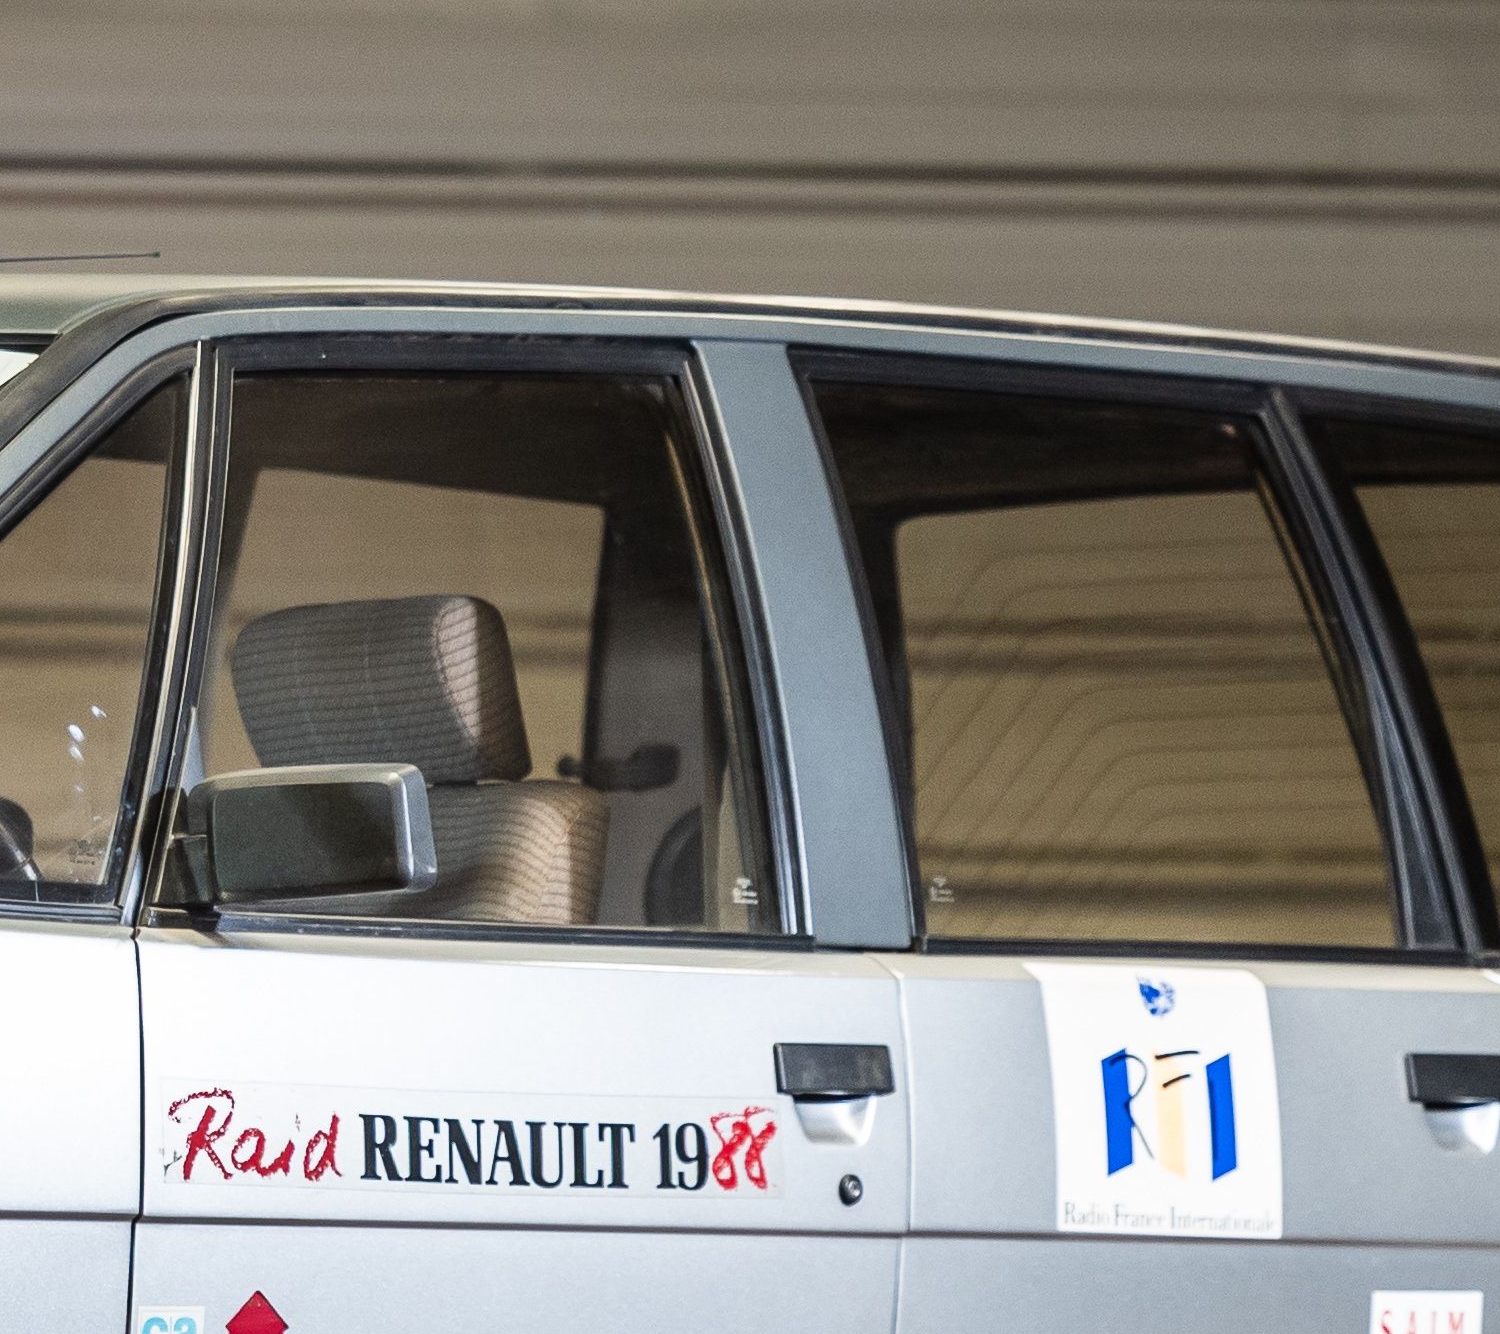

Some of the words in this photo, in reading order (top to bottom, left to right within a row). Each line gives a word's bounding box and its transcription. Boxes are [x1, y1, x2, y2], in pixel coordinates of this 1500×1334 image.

[167, 1086, 343, 1184] Raid
[358, 1113, 636, 1190] RENAULT
[652, 1107, 779, 1192] 1988
[1063, 1201, 1108, 1226] Radio
[1114, 1203, 1164, 1229] France
